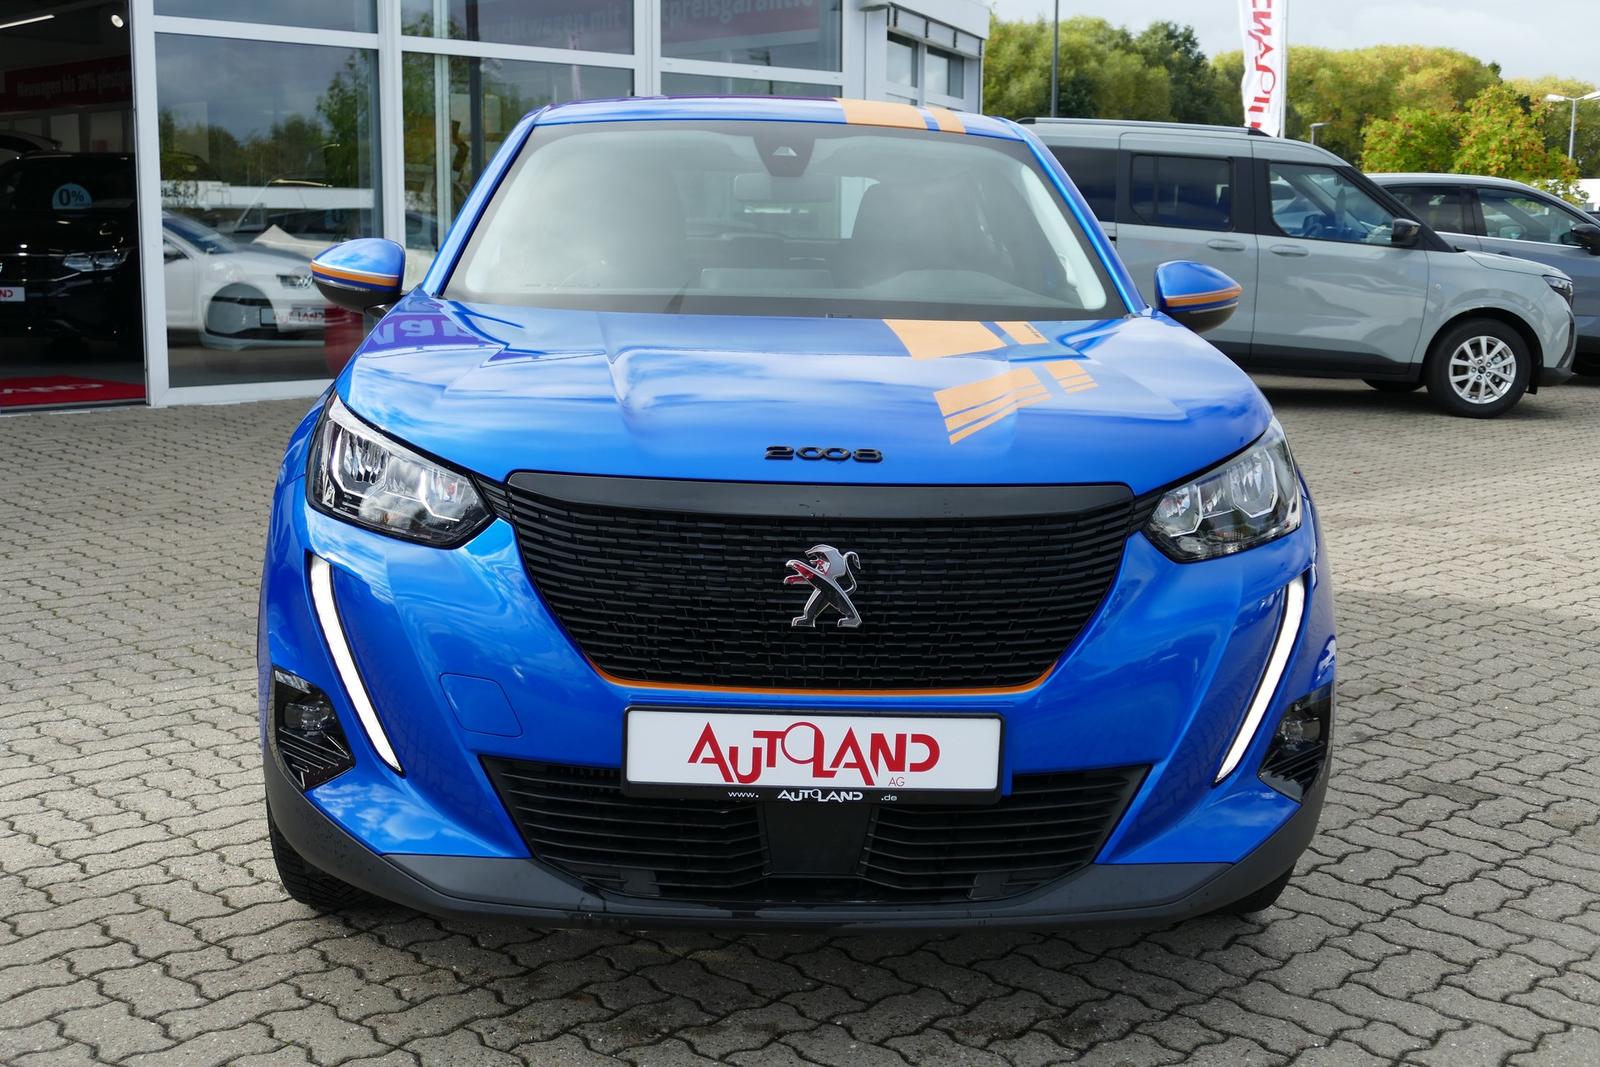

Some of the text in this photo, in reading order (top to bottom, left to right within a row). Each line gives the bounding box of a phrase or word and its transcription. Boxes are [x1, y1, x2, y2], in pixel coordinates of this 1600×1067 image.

[662, 0, 813, 32] tpreisgarantie
[58, 189, 85, 206] 0%
[0, 289, 13, 298] ND
[764, 446, 883, 463] 2008
[688, 721, 940, 786] AUTOLAND
[888, 777, 905, 787] AG
[777, 789, 863, 802] AUTOLAND
